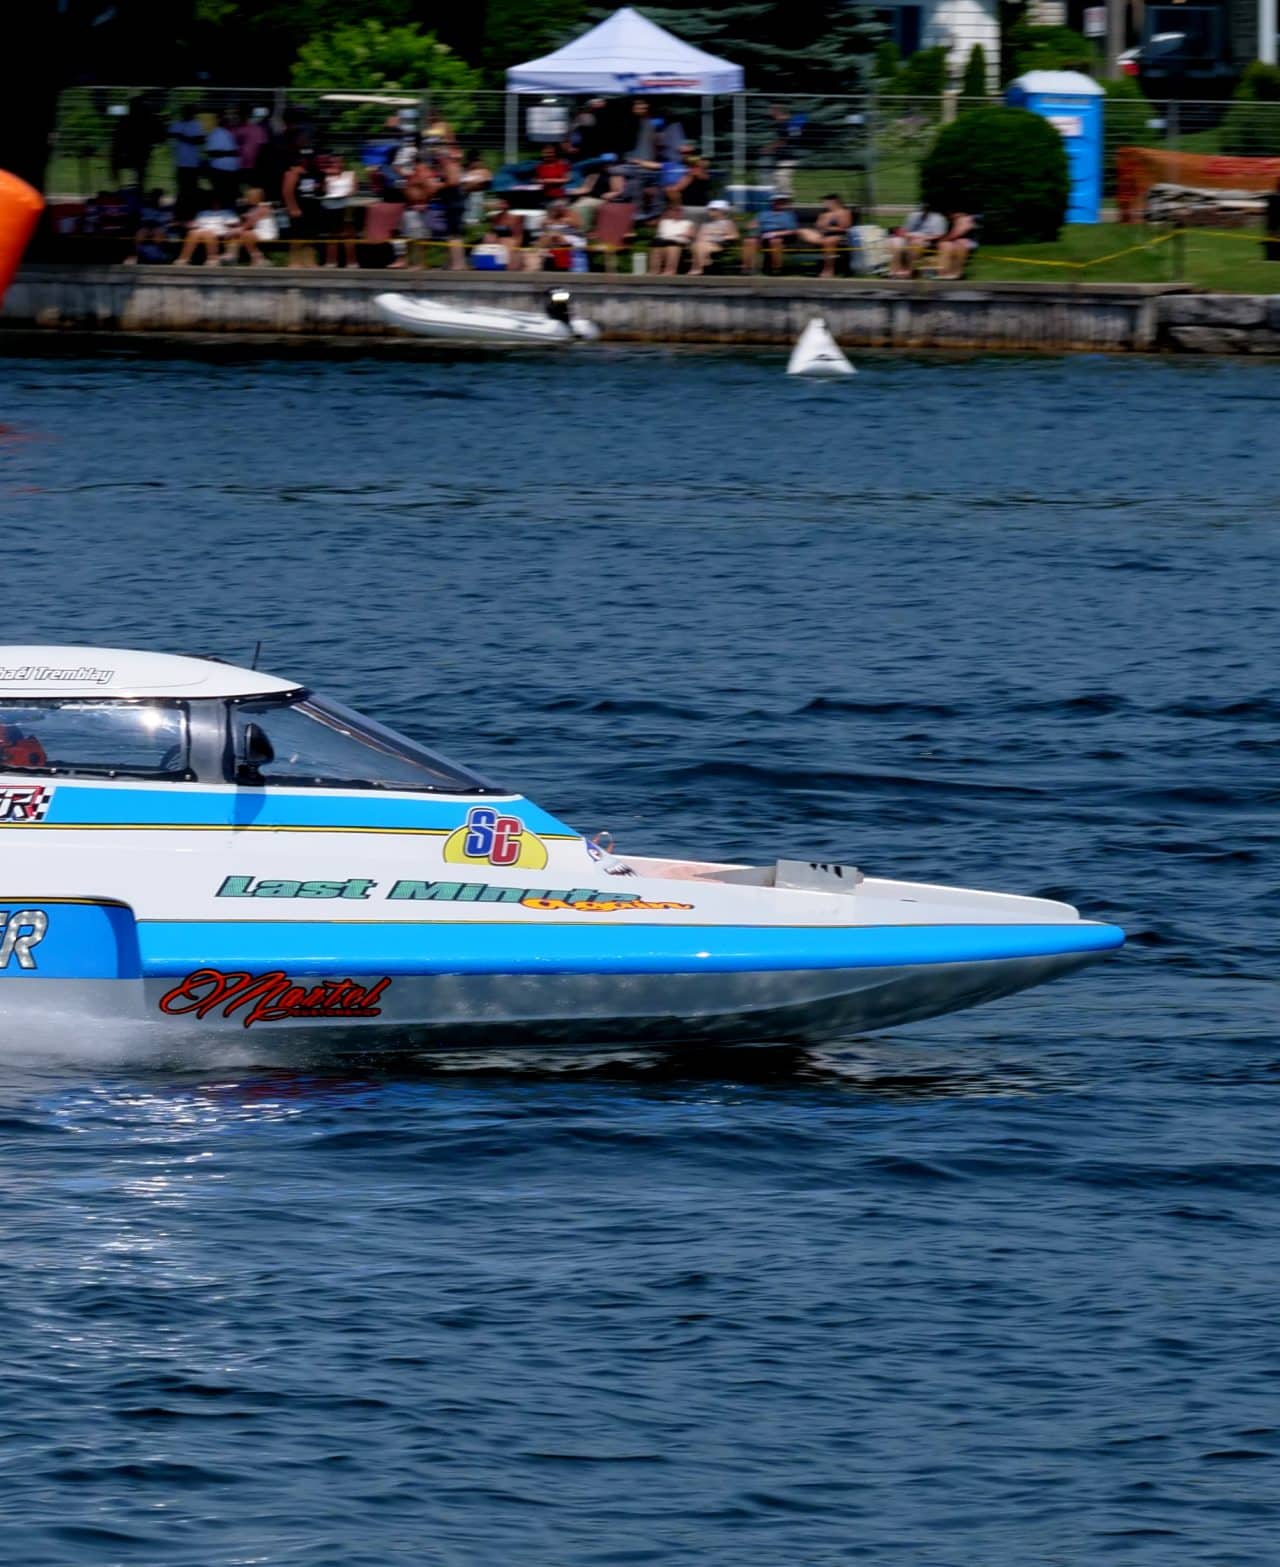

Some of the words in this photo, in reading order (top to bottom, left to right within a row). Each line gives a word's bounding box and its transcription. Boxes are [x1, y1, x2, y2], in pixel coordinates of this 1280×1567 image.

[34, 667, 114, 684] Tremblay
[465, 807, 521, 866] SC
[215, 876, 377, 899] Last
[385, 880, 641, 903] Minute
